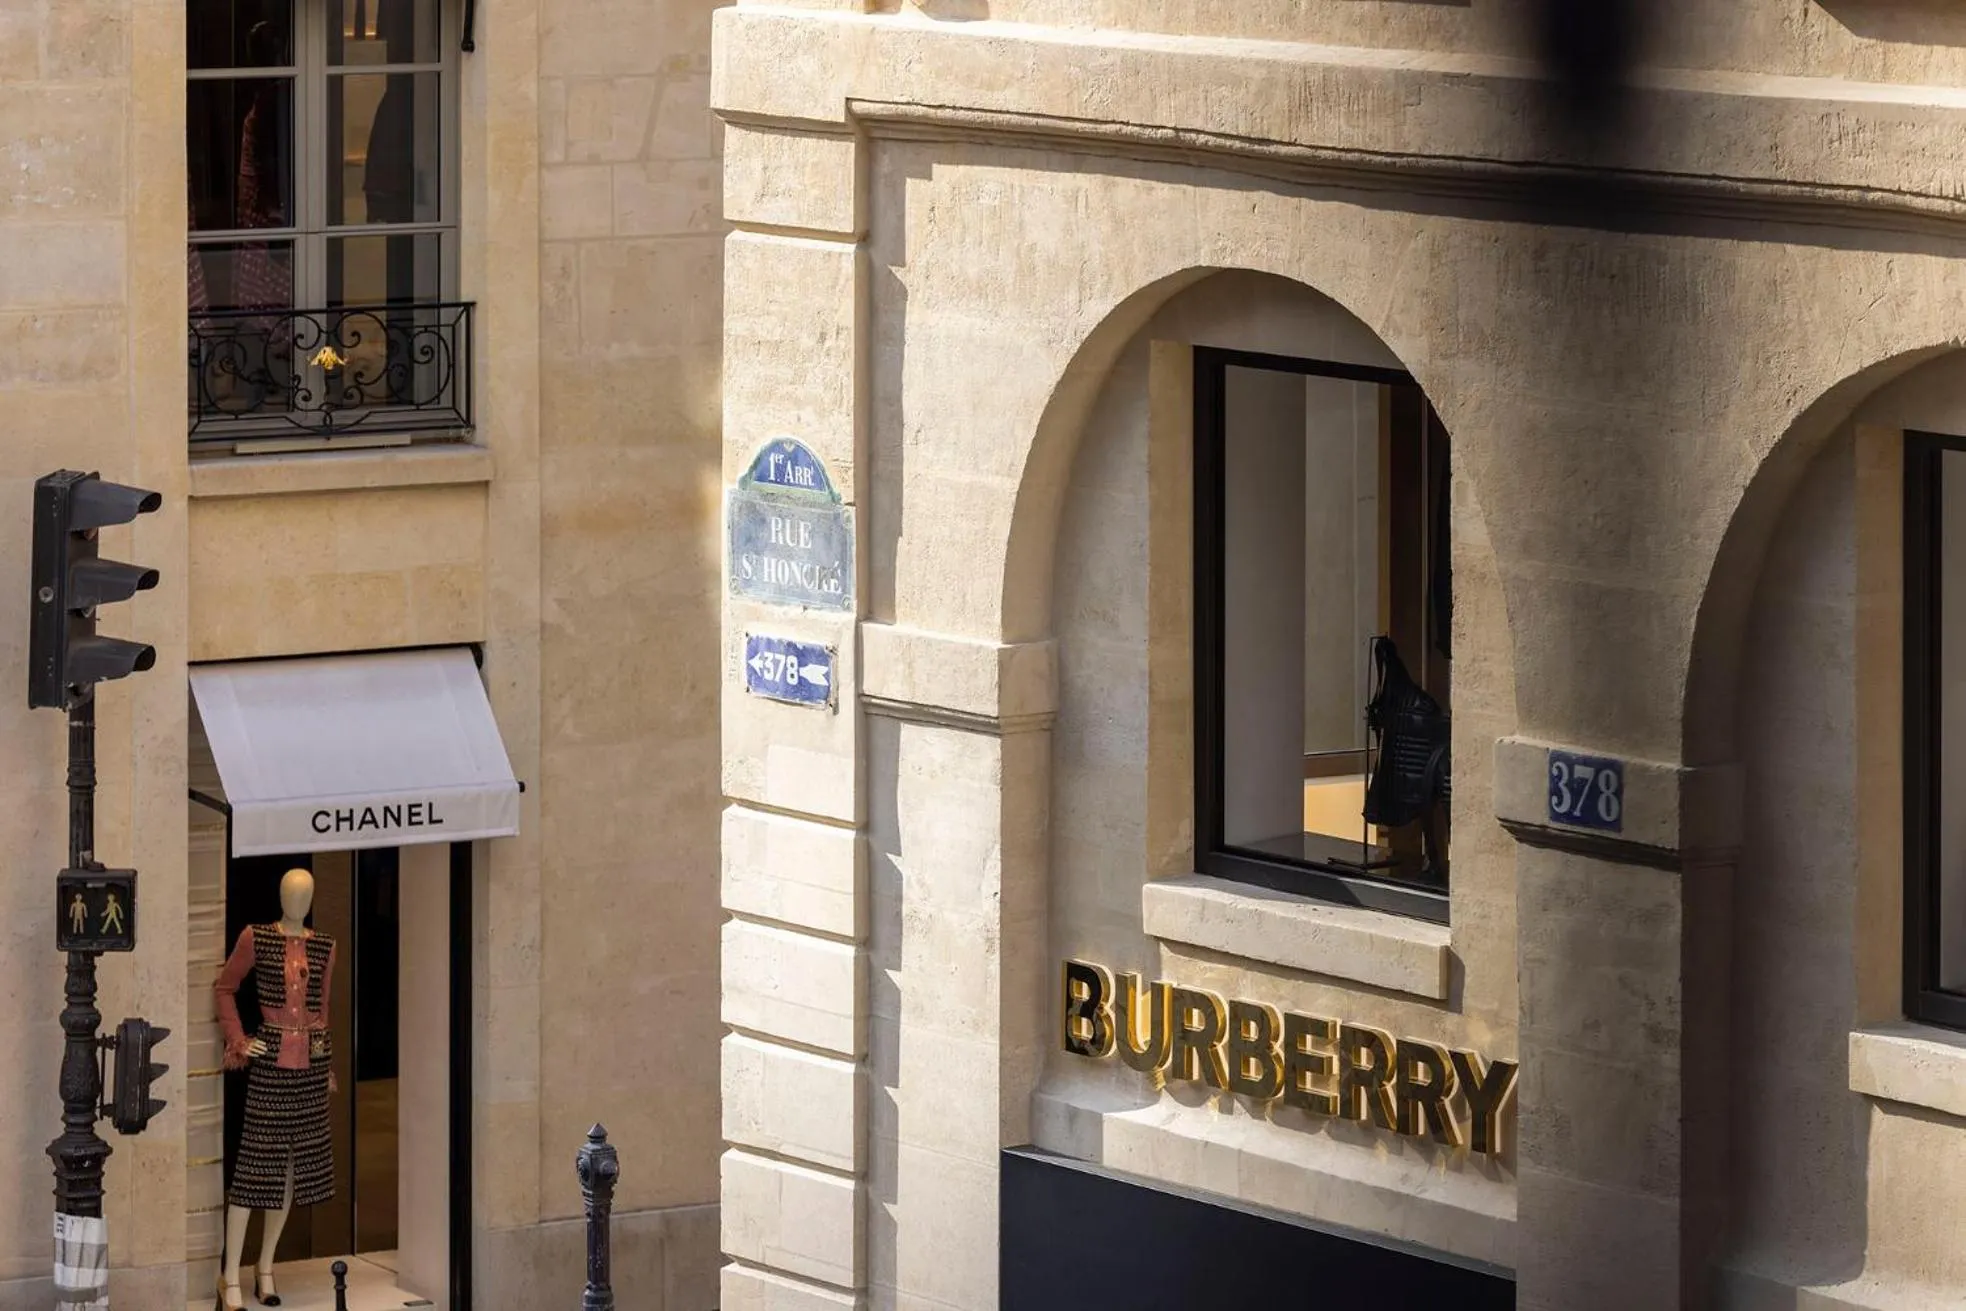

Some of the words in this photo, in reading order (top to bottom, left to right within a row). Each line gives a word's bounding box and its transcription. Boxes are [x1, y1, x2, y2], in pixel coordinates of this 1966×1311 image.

[770, 516, 812, 549] RUE
[763, 650, 799, 686] 378
[1551, 761, 1620, 823] 378
[311, 801, 444, 833] CHANEL
[1062, 959, 1519, 1153] BURBERRY
